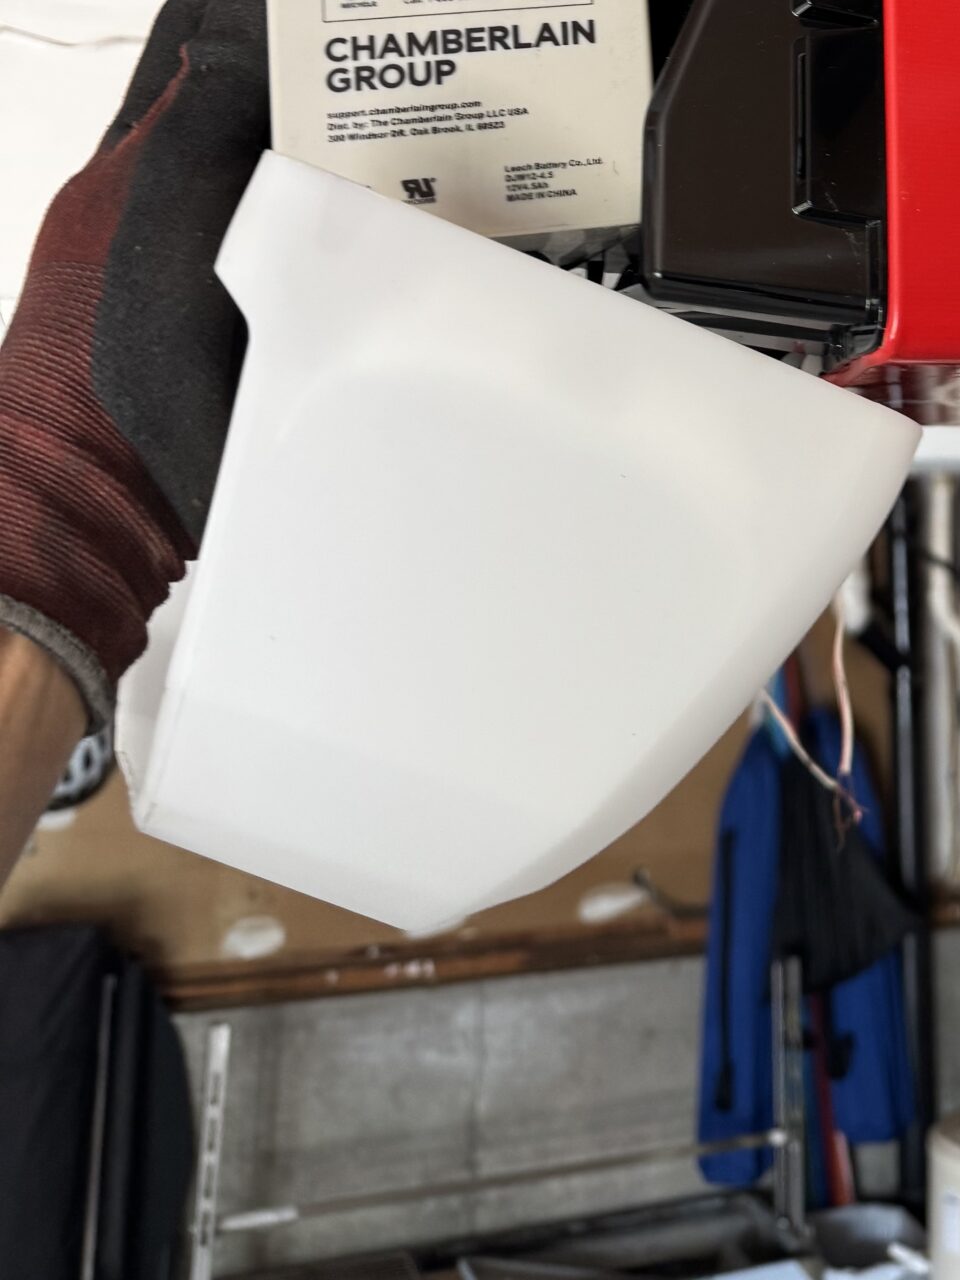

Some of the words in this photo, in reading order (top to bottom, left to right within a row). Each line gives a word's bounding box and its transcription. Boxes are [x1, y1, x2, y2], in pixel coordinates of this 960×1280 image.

[324, 19, 597, 62] CHAMBERLAIN
[326, 59, 457, 93] GROUP
[326, 100, 482, 119] support.chamberlaingroup.com
[370, 118, 389, 127] The
[390, 113, 453, 126] Chamberlain
[454, 111, 485, 121] Group
[486, 108, 506, 118] LLC
[507, 107, 529, 117] USA
[346, 131, 389, 141] Windsor
[409, 127, 430, 136] Oak
[465, 123, 475, 132] IL
[534, 161, 567, 170] Battery
[506, 191, 533, 202] MADE
[535, 191, 545, 200] IN
[546, 188, 577, 199] CHINA
